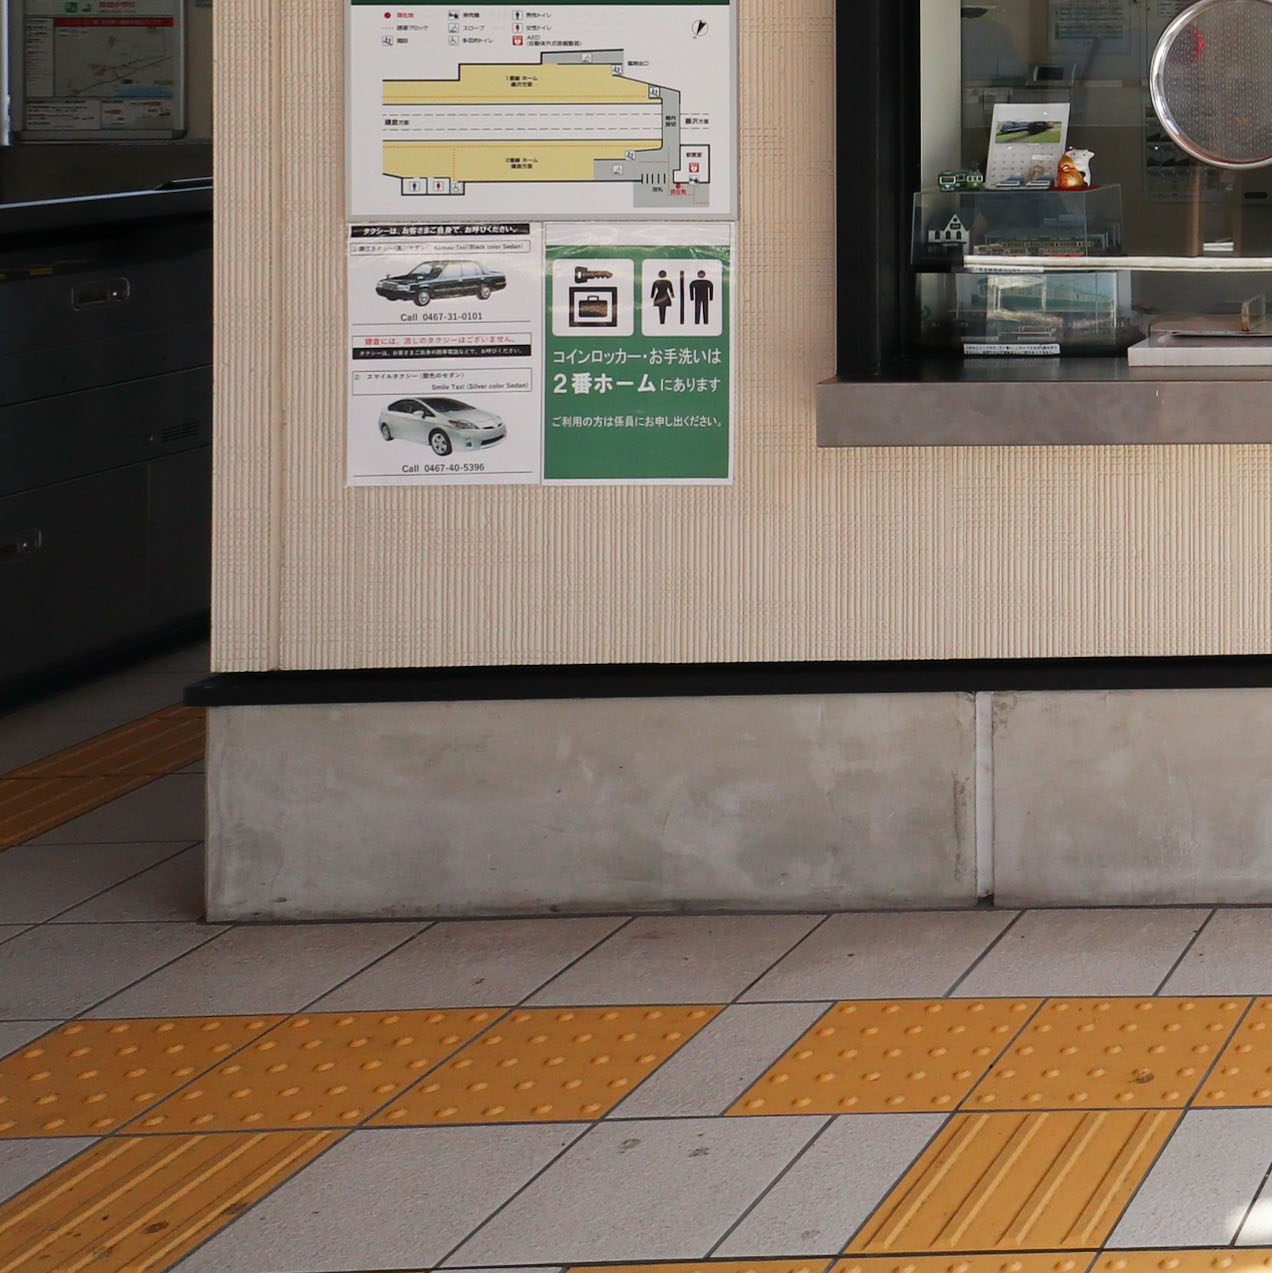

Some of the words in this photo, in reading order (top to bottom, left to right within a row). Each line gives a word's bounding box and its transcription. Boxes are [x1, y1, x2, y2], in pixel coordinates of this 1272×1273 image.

[423, 312, 482, 321] 0467-31-0101
[553, 348, 721, 365] コインロッカー・お手洗いは
[552, 415, 722, 428] ご利用の方は係員にお申し出ください。
[402, 464, 419, 473] Call
[424, 462, 485, 472] 0467-40-5396
